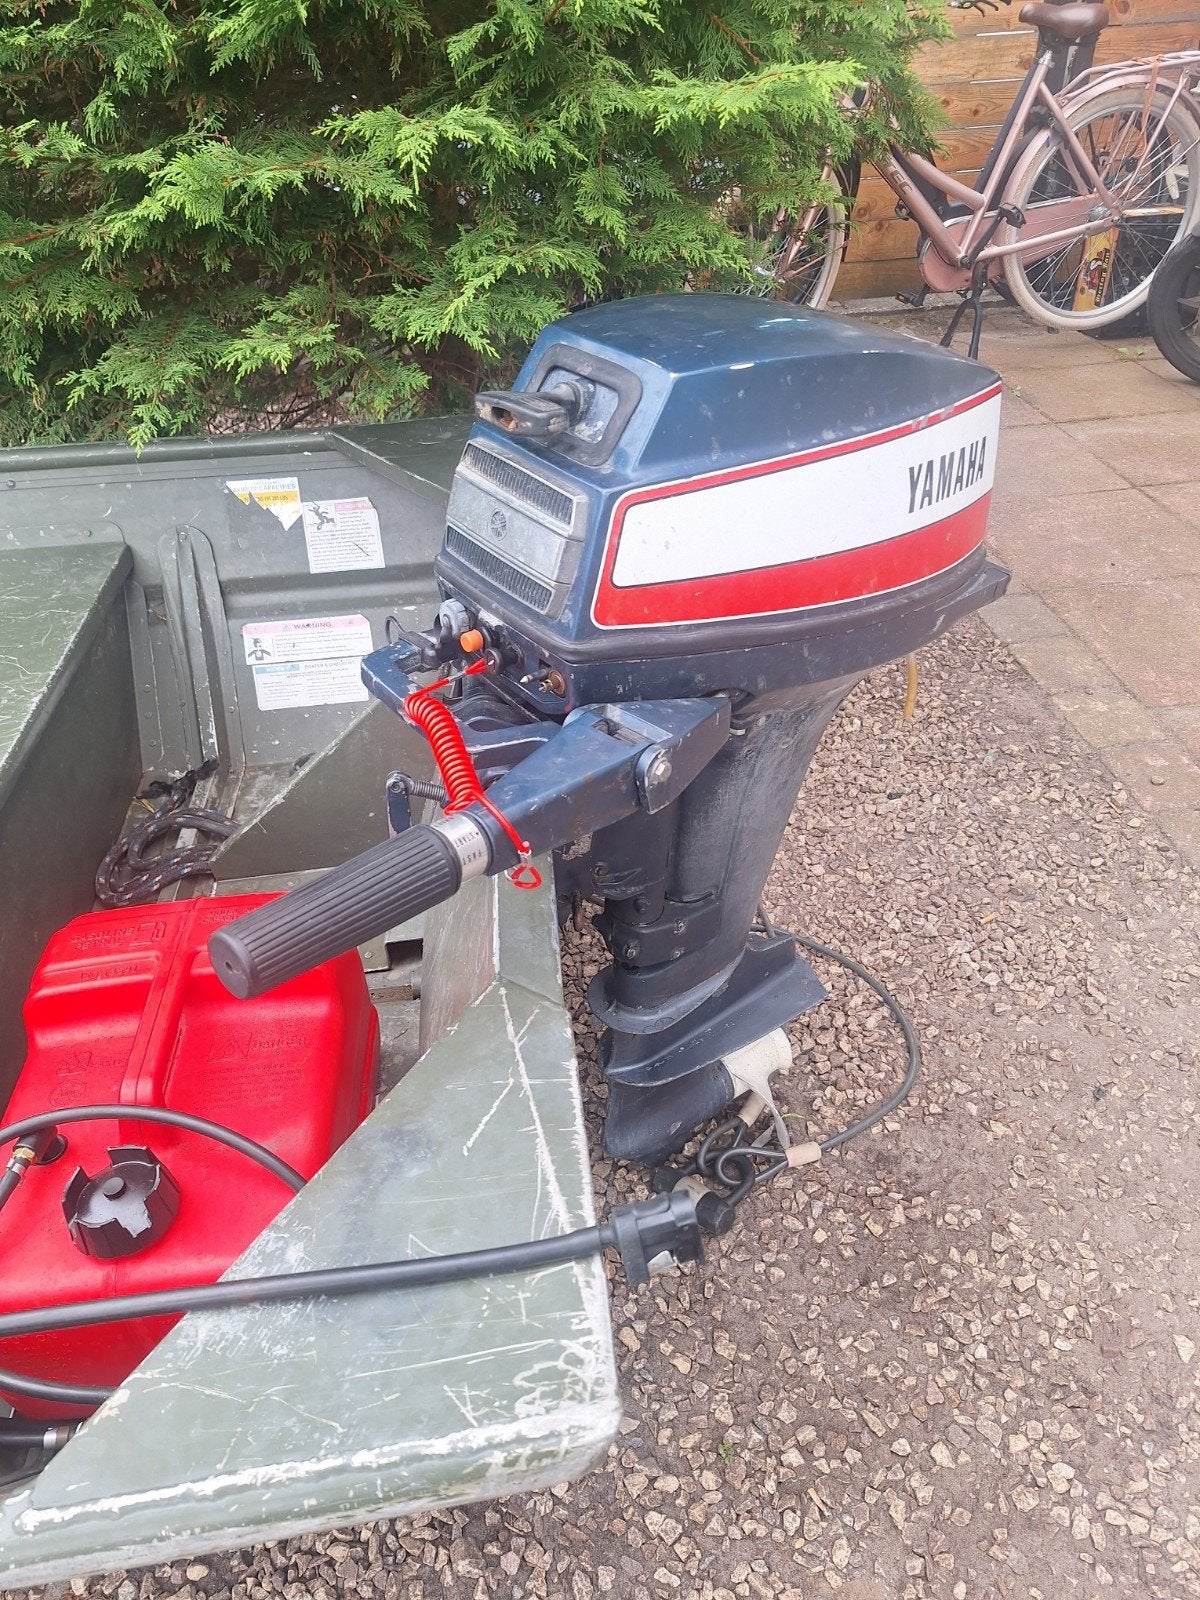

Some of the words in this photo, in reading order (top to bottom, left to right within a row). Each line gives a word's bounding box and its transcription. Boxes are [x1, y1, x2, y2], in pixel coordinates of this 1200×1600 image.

[908, 436, 987, 514] YAMAHA
[293, 621, 332, 630] WARNING
[455, 832, 475, 848] START
[462, 849, 482, 866] FAST
